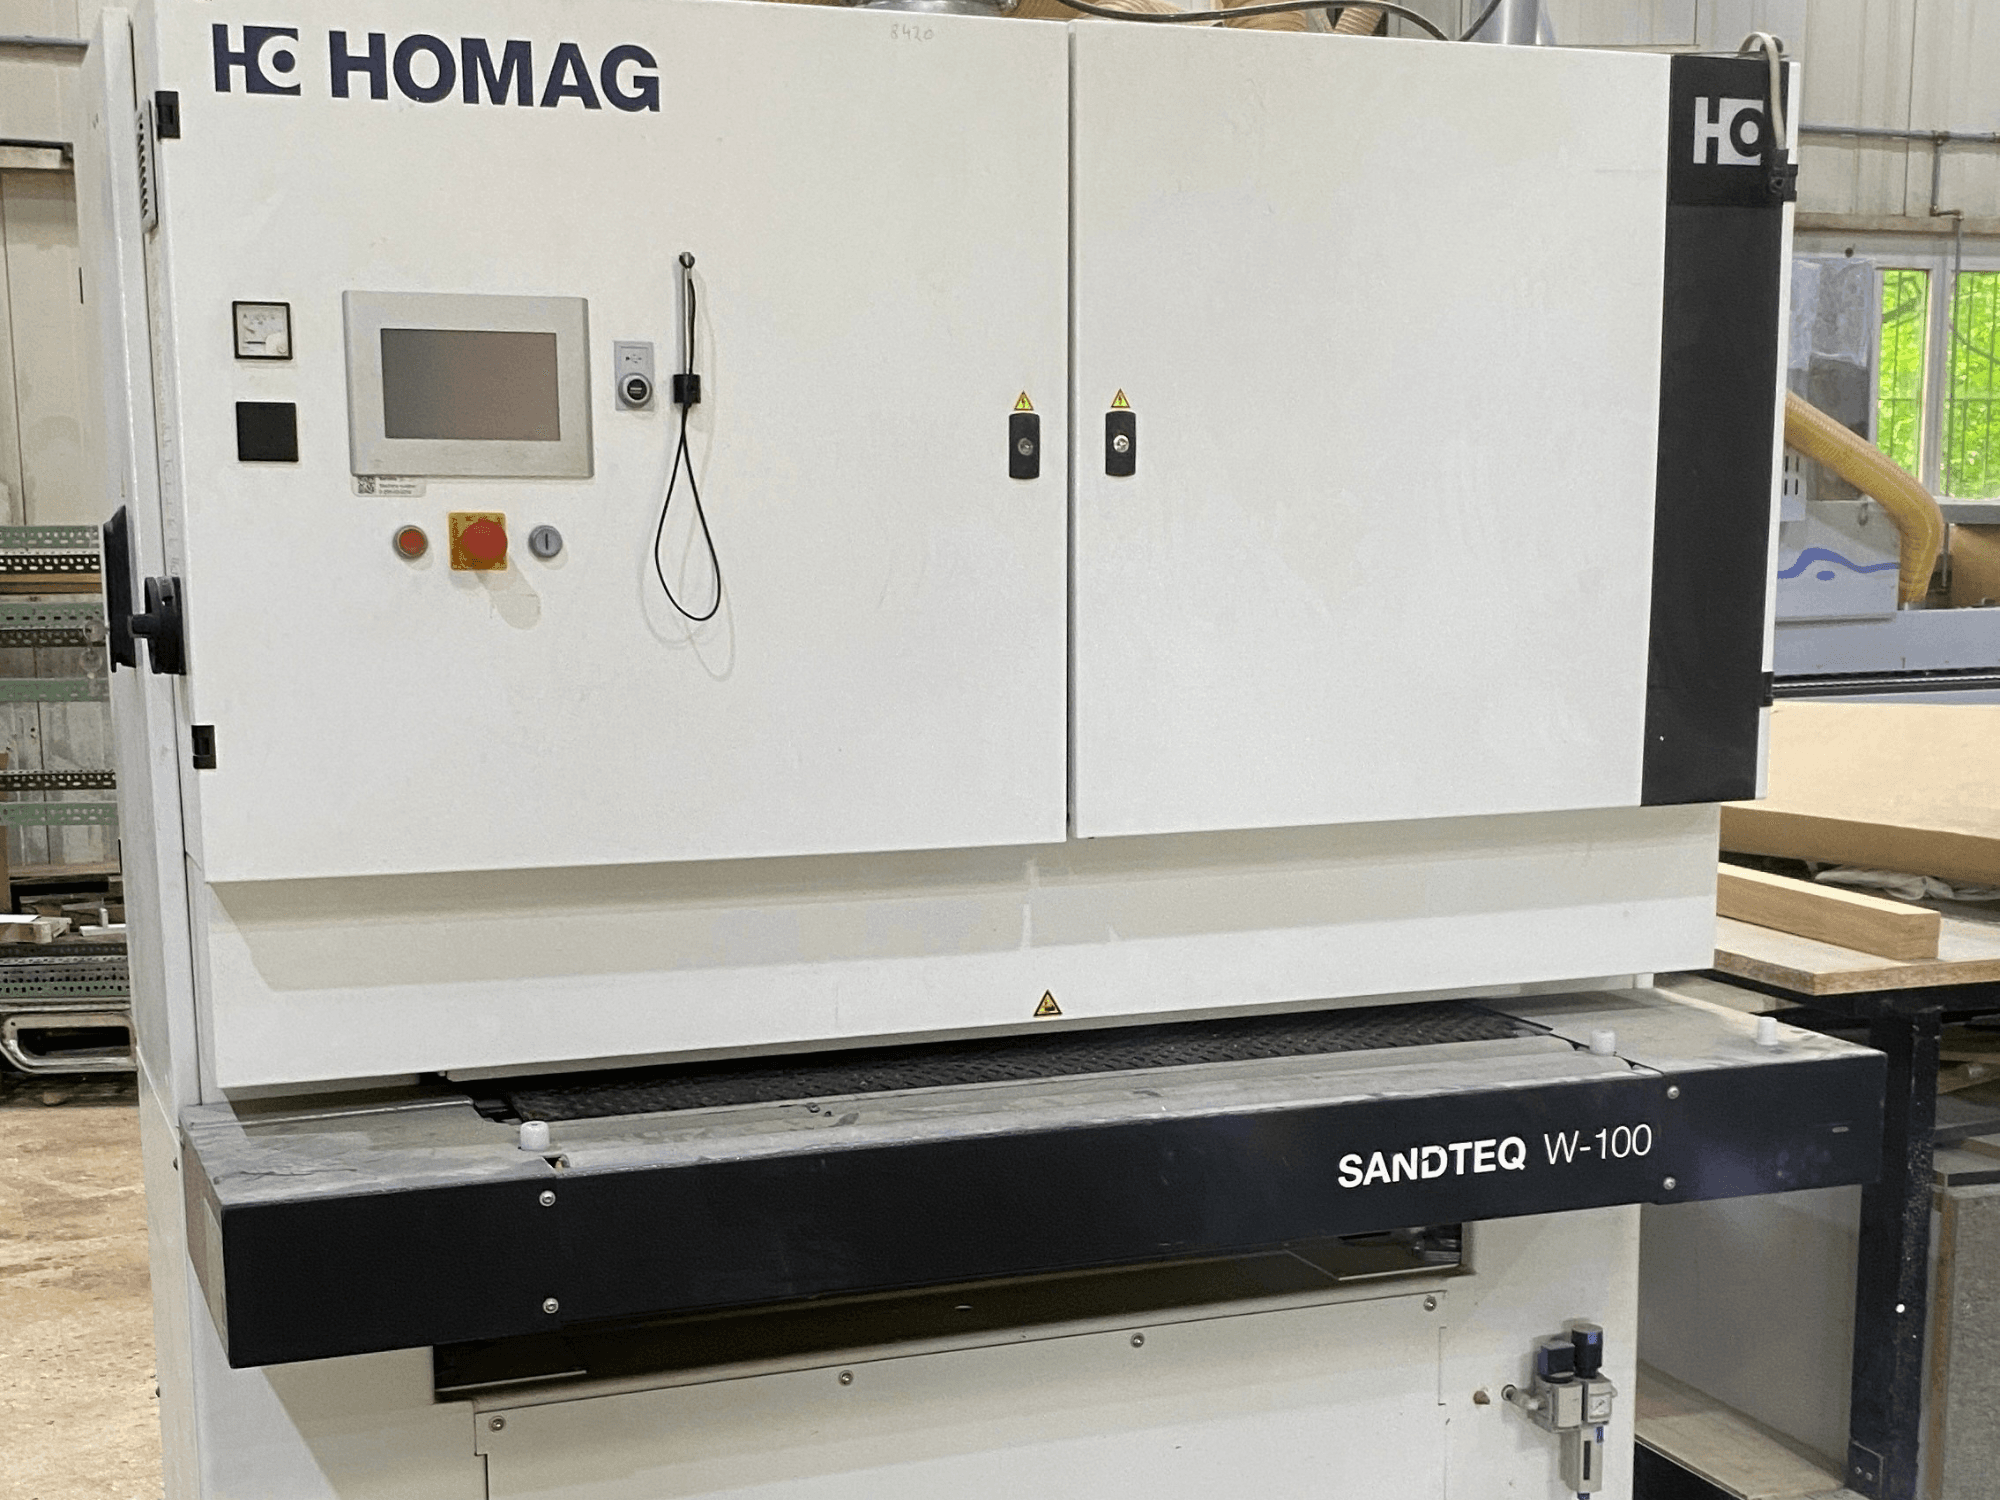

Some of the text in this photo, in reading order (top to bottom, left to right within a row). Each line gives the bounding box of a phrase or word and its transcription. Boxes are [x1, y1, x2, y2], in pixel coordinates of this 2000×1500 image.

[889, 22, 935, 42] 8420
[329, 31, 660, 112] HOMAG
[1338, 1124, 1652, 1188] SANDTEQ W-100
